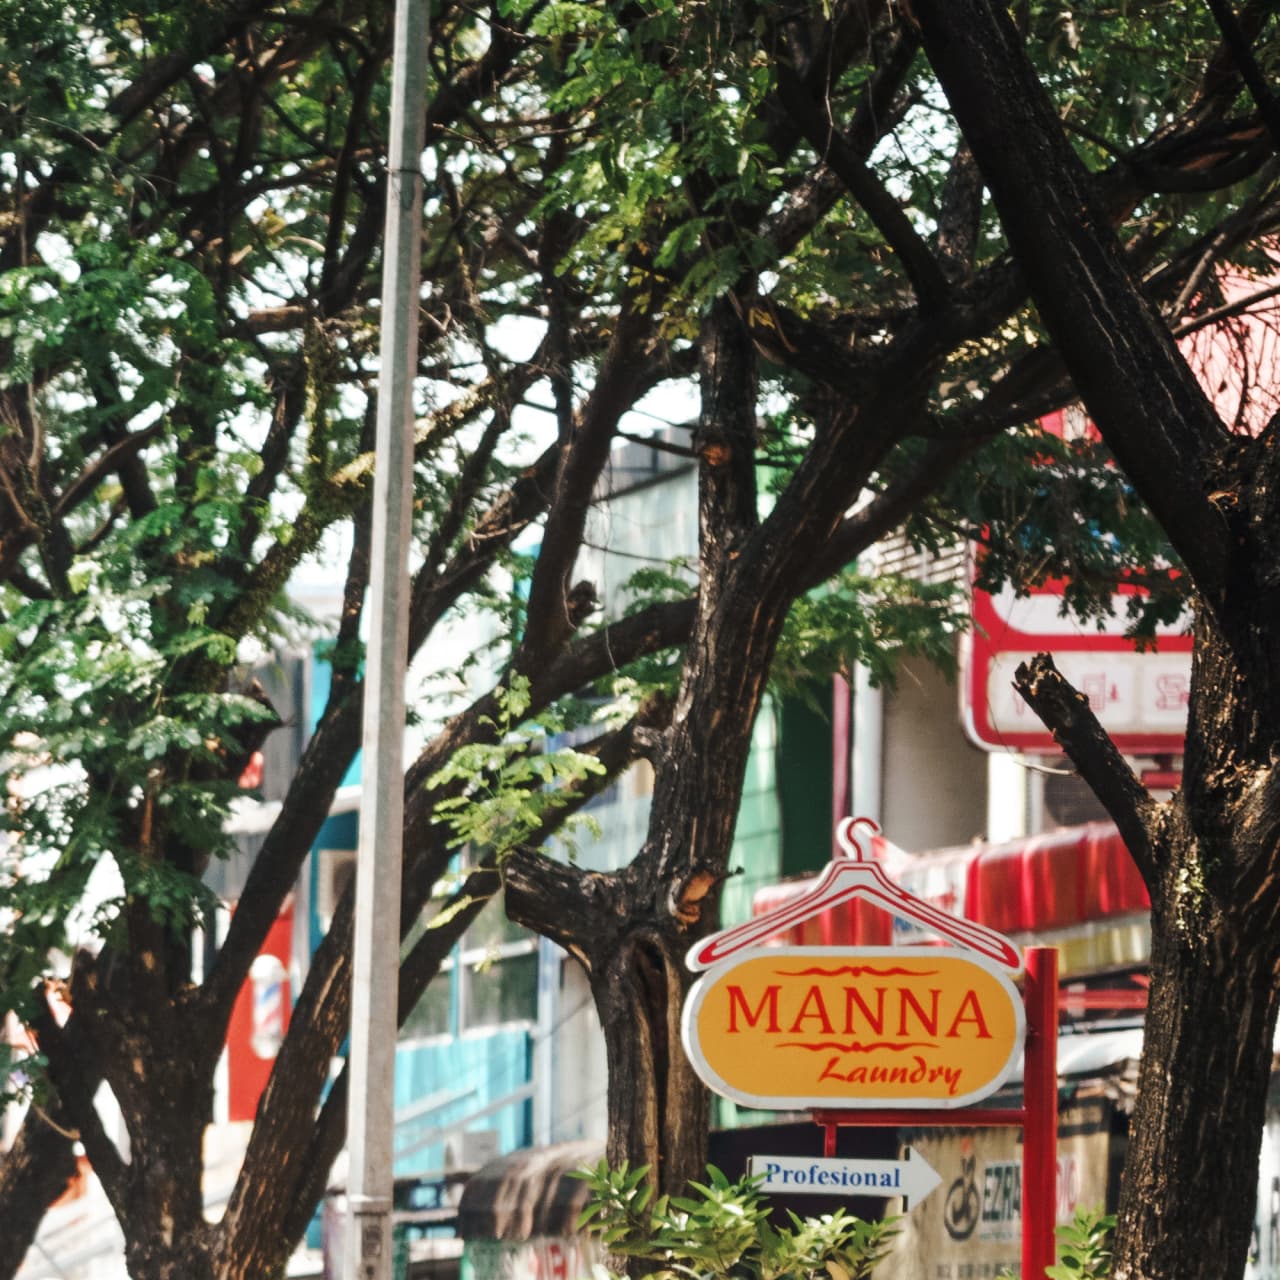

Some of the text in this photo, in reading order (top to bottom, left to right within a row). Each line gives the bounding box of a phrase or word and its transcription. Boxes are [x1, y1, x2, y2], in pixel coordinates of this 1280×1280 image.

[725, 985, 993, 1039] MANNA
[817, 1055, 963, 1096] Laundry
[765, 1163, 901, 1188] Profesional
